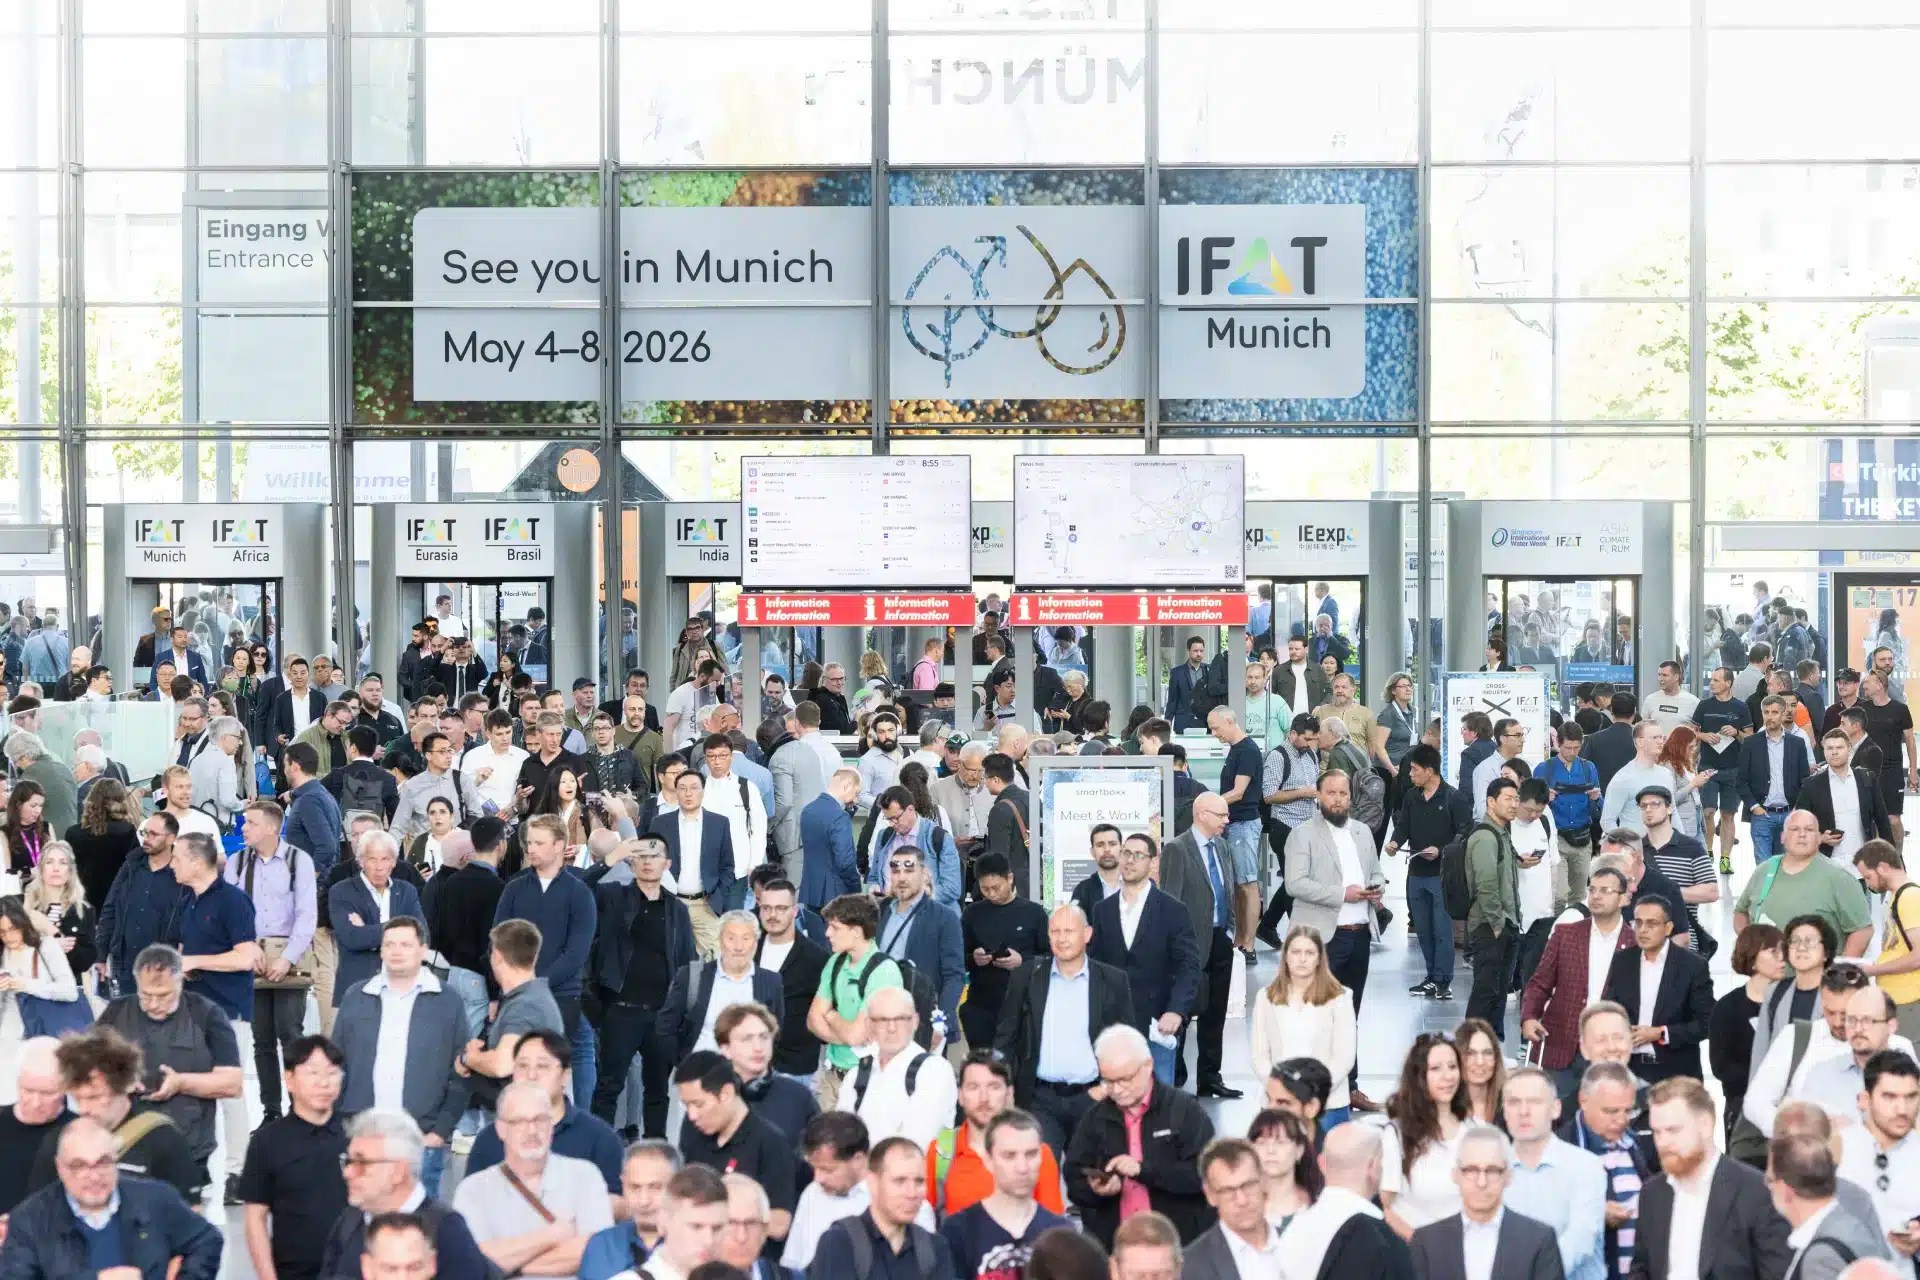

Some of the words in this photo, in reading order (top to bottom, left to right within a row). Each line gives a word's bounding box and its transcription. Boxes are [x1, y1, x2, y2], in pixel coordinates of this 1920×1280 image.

[207, 219, 307, 242] Eingang
[207, 250, 314, 269] Entrance
[443, 250, 518, 284] See
[531, 256, 601, 293] you
[623, 250, 659, 283] in
[676, 249, 834, 284] Munich
[1178, 237, 1327, 296] IFAT
[1207, 318, 1332, 350] Munich
[443, 331, 524, 373] May
[623, 330, 711, 364] 2026
[264, 472, 436, 488] Willkmme!
[1859, 463, 1920, 485] Türki
[136, 519, 185, 542] IFAT
[212, 519, 268, 542] IFAT
[407, 518, 457, 541] IFAT
[485, 518, 540, 541] IFAT
[677, 518, 728, 541] IFAT
[1556, 536, 1582, 547] IFAT
[143, 550, 187, 562] Munich
[233, 549, 270, 562] Africa
[416, 549, 458, 561] Eurasia
[507, 548, 541, 561] Brasil
[699, 548, 729, 561] India
[765, 597, 830, 608] Information
[884, 597, 949, 608] Information
[1038, 597, 1103, 608] Information
[1157, 597, 1222, 608] Information
[765, 611, 830, 621] Information
[884, 611, 949, 621] Information
[1038, 611, 1103, 621] Information
[1157, 611, 1222, 621] Information
[1453, 697, 1474, 705] IFAT
[1516, 697, 1538, 705] IFAT
[1075, 788, 1127, 796] smartboxx
[1060, 810, 1092, 821] Meet
[1096, 810, 1105, 821] &
[1109, 810, 1142, 821] Work
